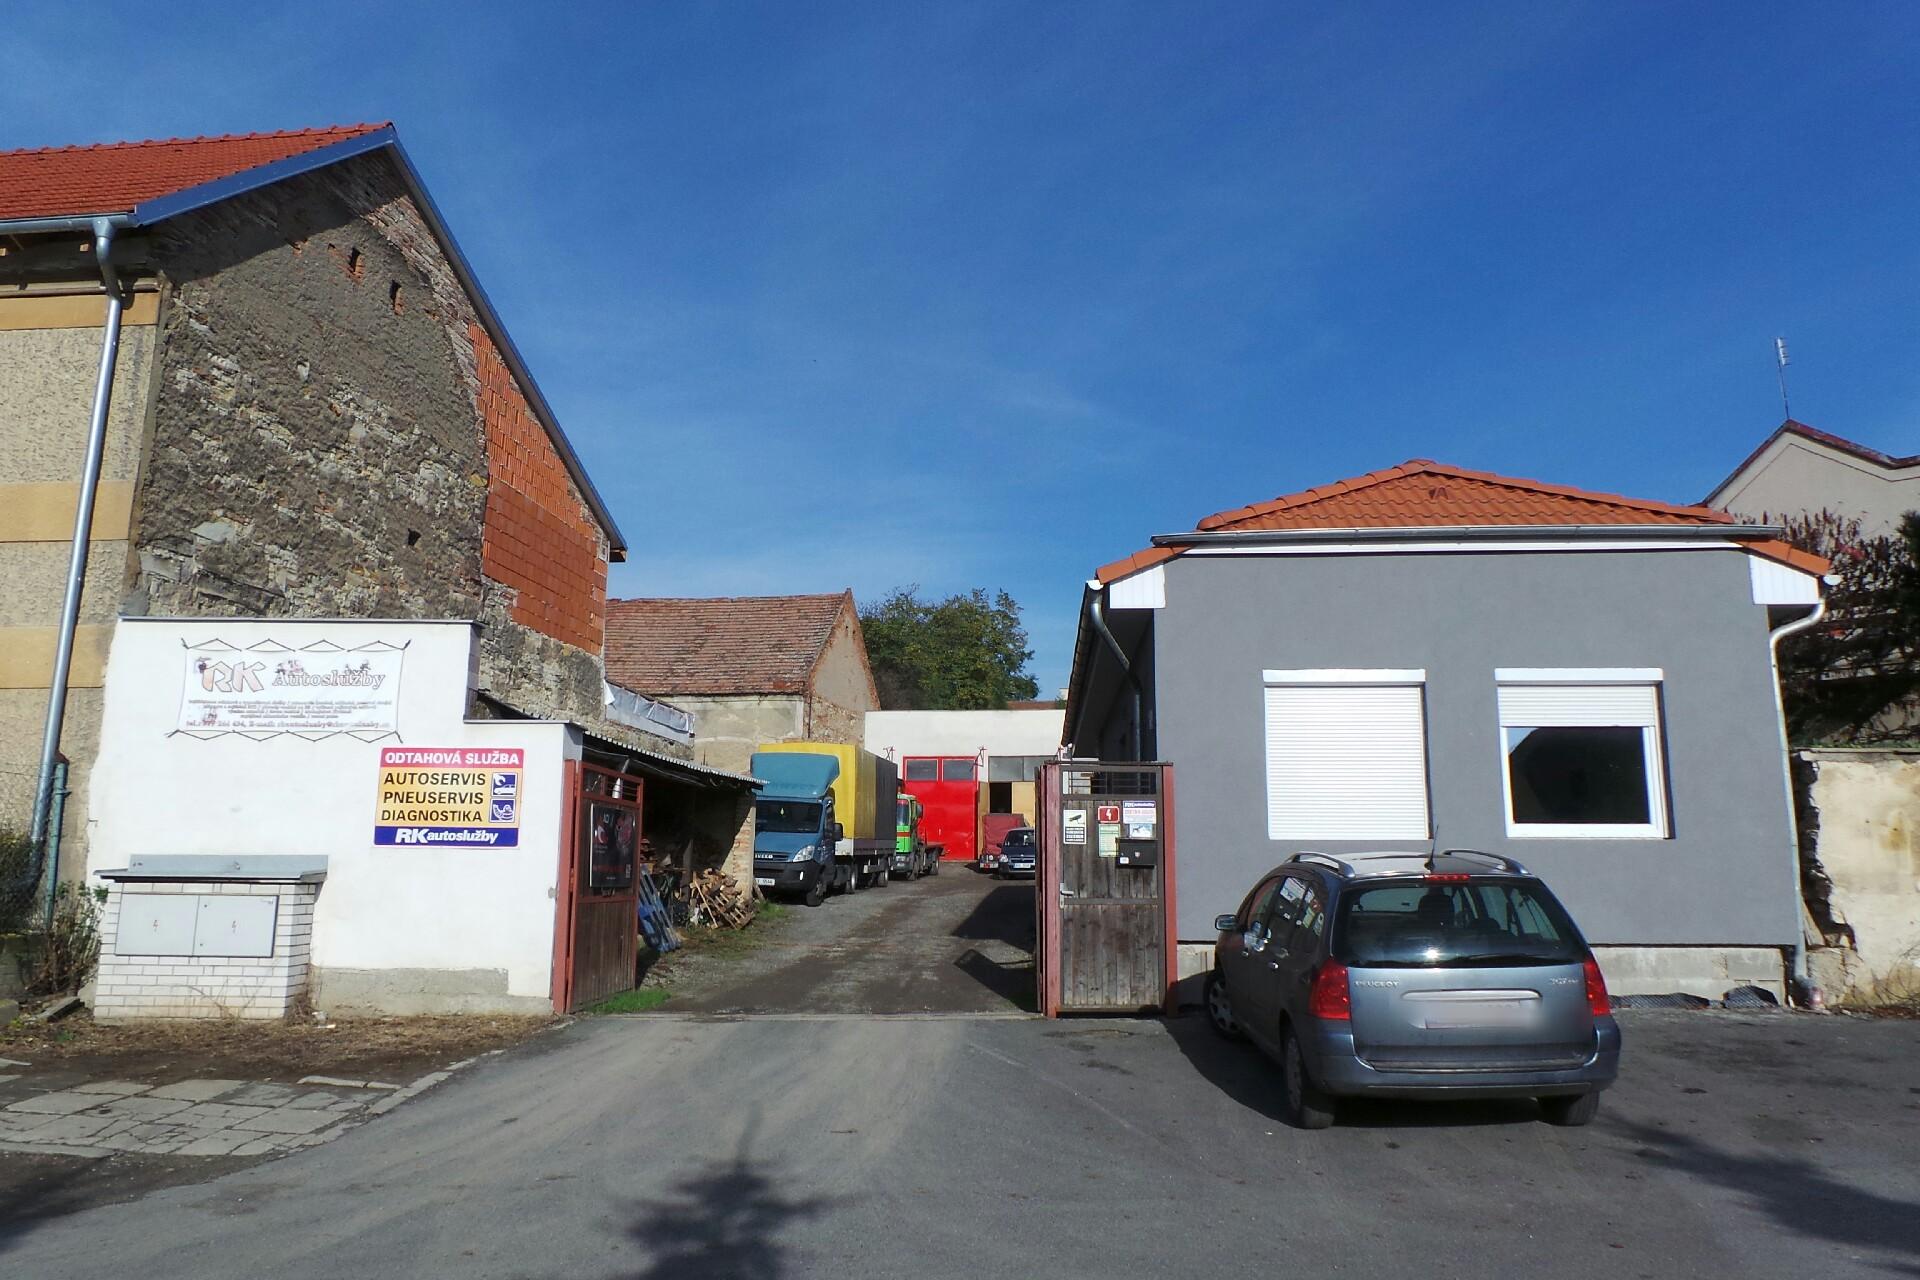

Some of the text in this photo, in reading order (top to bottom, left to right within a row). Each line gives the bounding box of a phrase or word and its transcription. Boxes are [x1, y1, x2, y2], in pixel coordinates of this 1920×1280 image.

[202, 661, 266, 693] RK
[385, 749, 519, 765] ODTAHOVÁ SLUŽBA
[384, 772, 486, 785] AUTOSERVIS
[383, 791, 484, 804] PNEUSERVIS
[381, 810, 482, 822] DIAGNOSTIKA
[1105, 808, 1112, 821] 4
